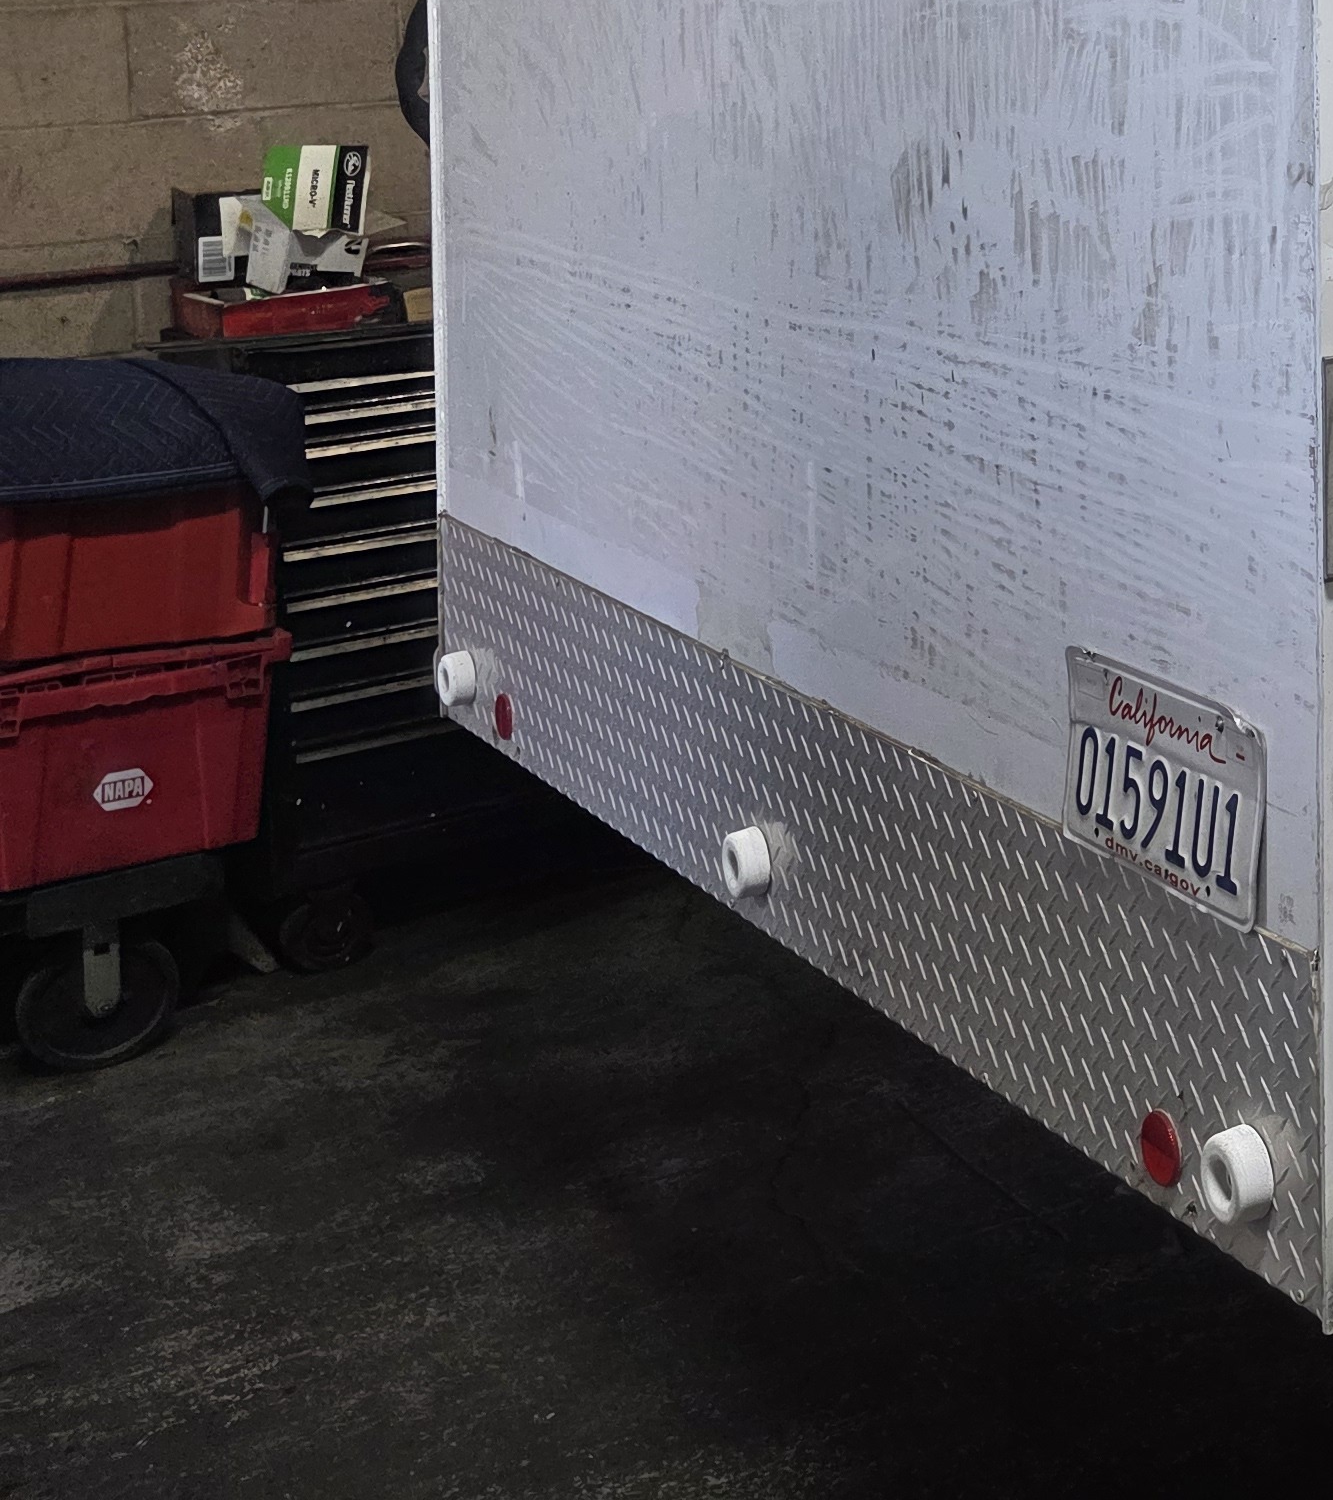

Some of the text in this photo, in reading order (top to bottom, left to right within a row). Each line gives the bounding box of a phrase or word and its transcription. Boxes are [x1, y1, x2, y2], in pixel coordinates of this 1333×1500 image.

[1109, 676, 1226, 764] California
[104, 778, 143, 801] NAPA
[1075, 727, 1239, 896] 01591U1
